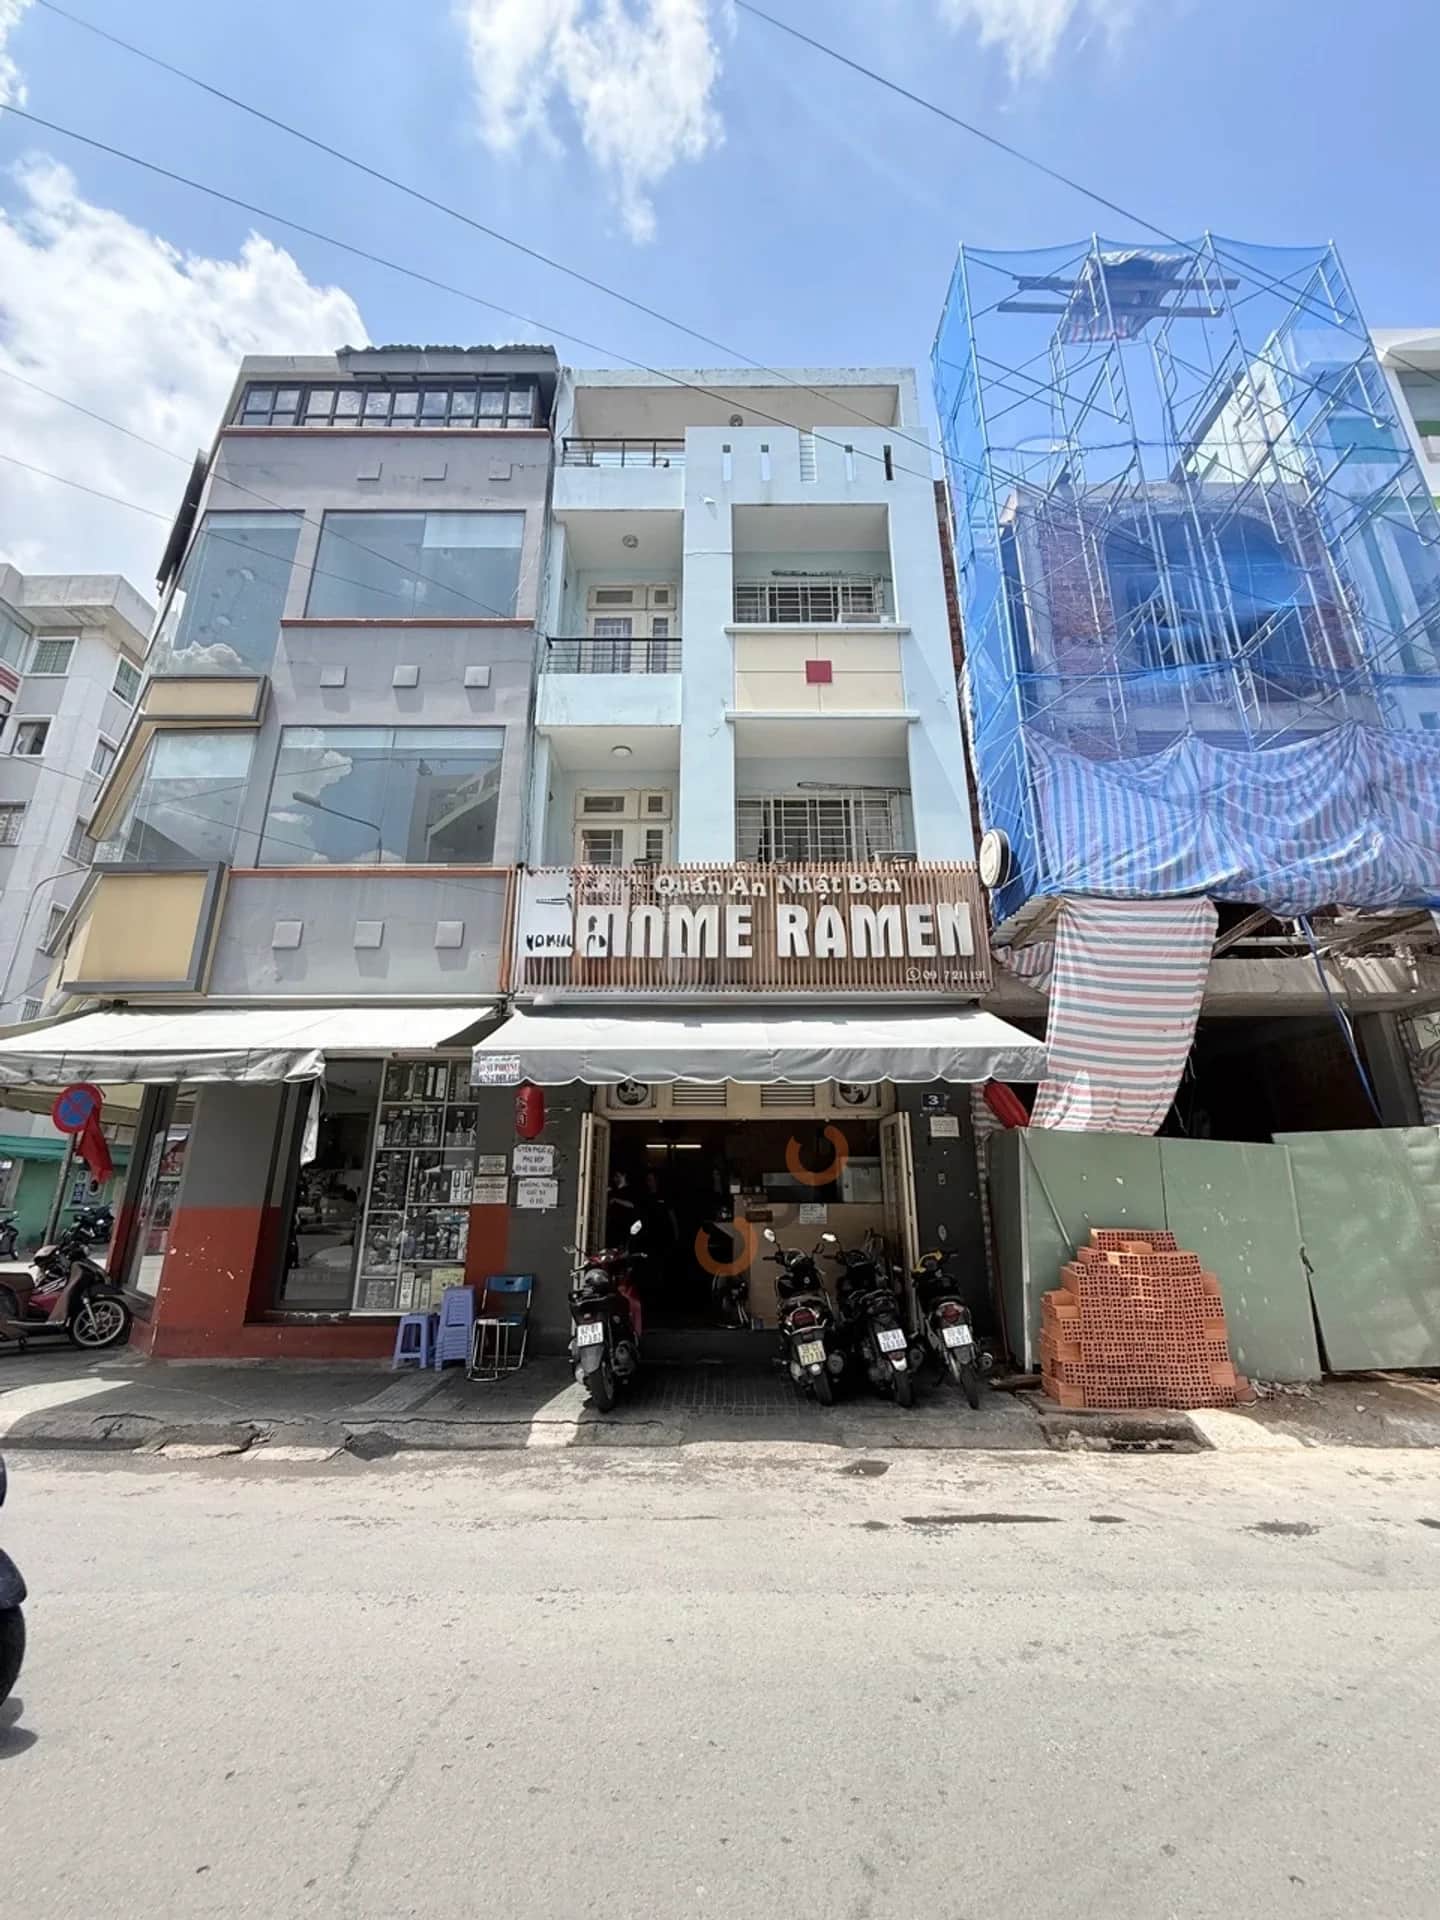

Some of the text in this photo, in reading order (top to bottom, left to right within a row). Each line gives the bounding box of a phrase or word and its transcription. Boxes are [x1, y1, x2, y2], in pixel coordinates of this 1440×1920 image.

[654, 873, 722, 896] Quán
[777, 873, 842, 900] Nhật
[777, 901, 975, 958] RAMEN
[927, 1094, 940, 1105] 3
